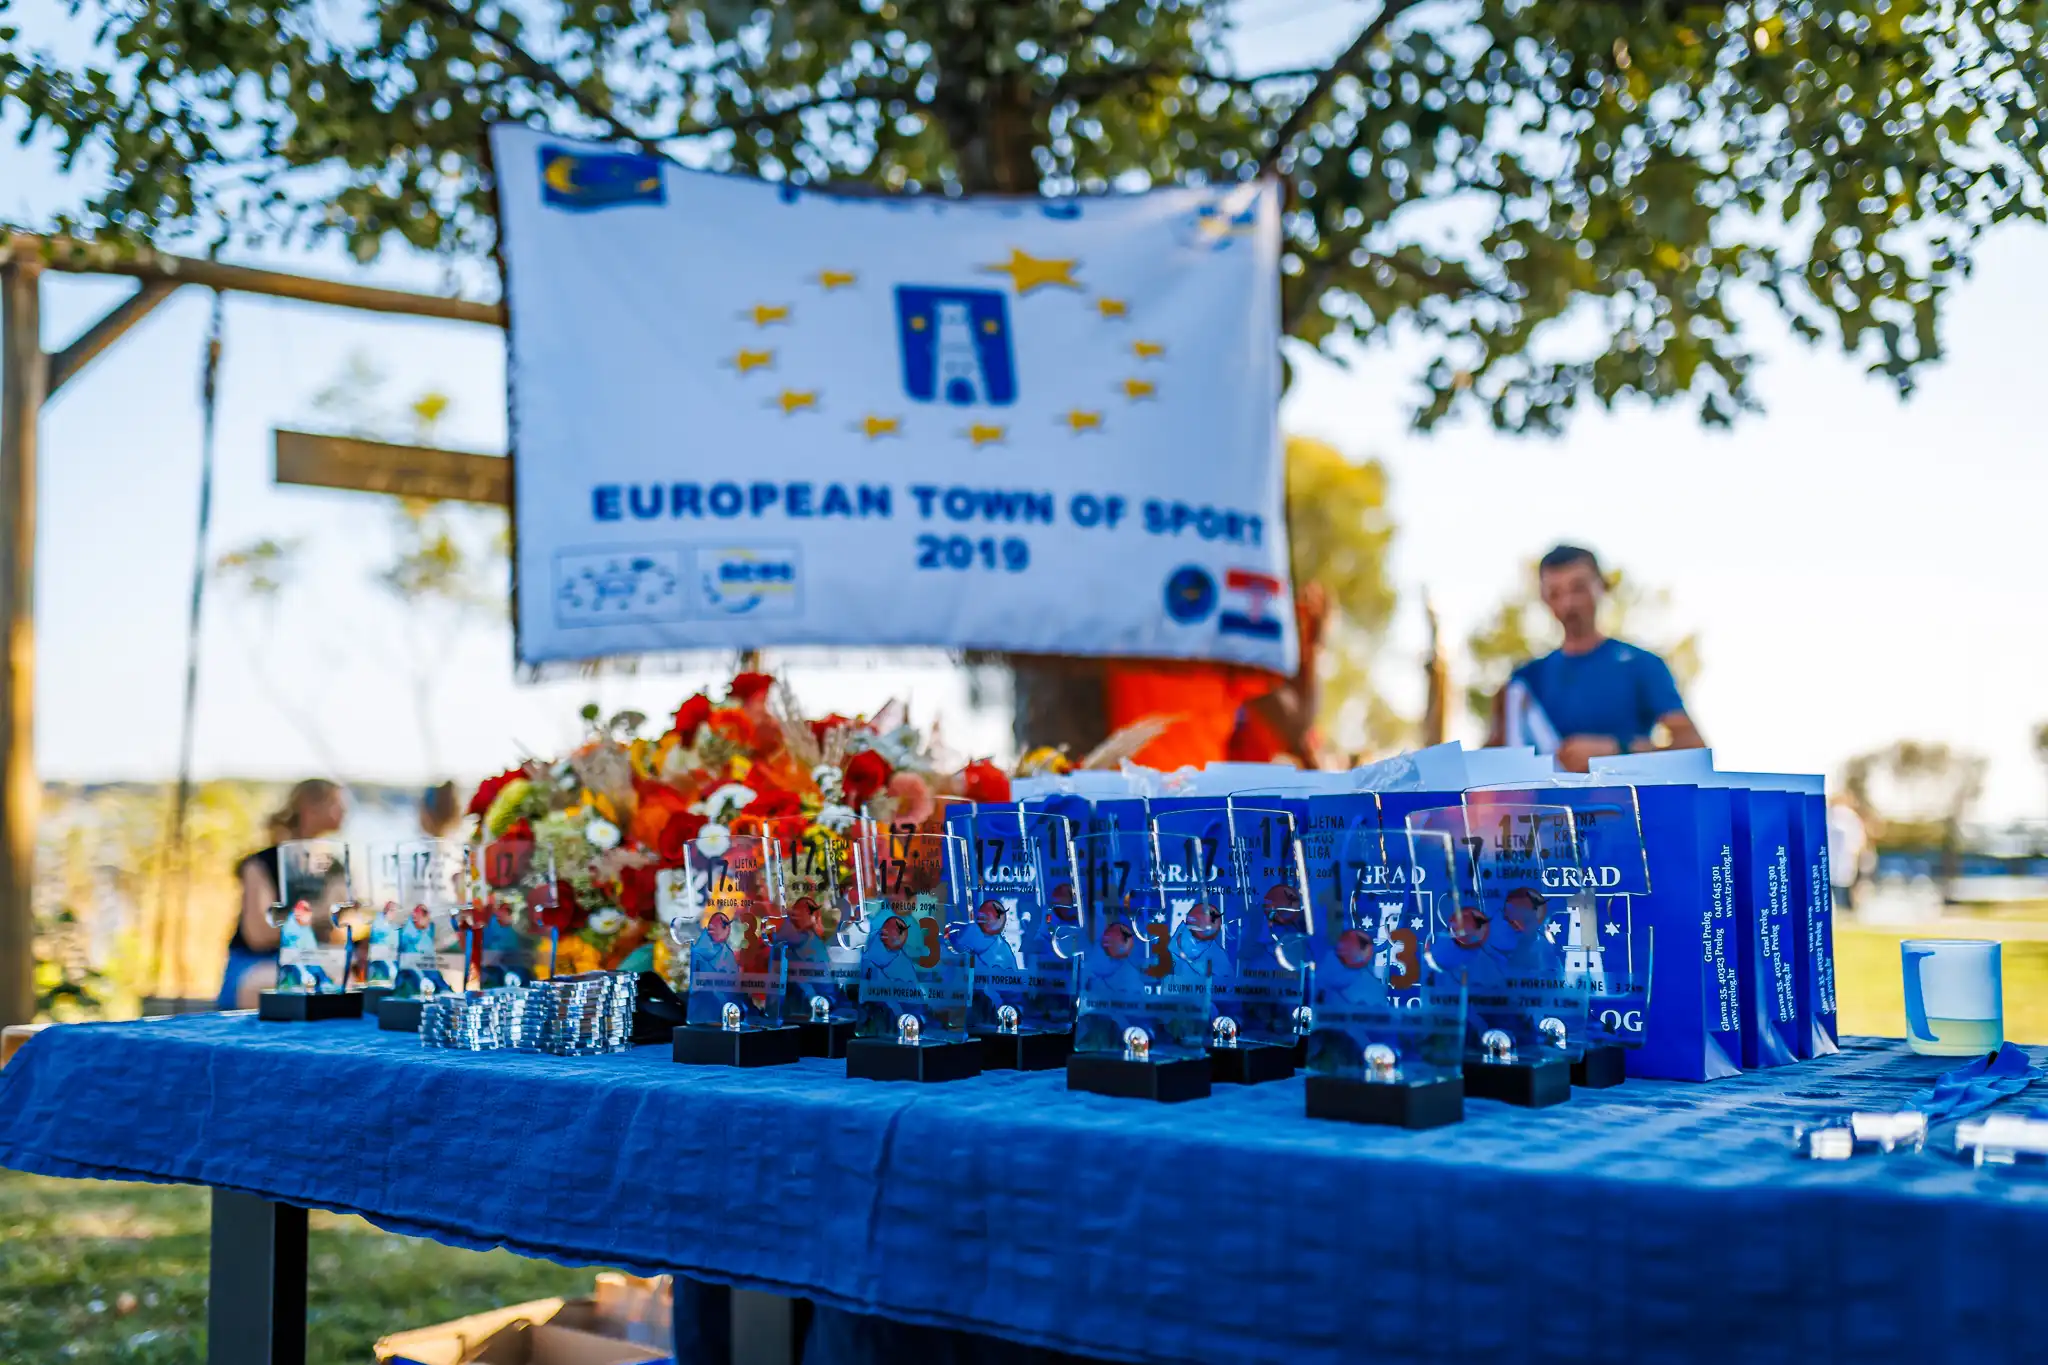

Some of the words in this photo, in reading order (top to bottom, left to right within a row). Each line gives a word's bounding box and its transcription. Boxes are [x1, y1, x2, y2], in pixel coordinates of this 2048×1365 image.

[592, 483, 892, 521] EUROPEAN
[909, 486, 1054, 524] TOWN
[1070, 493, 1123, 528] OF
[1144, 499, 1262, 547] SPORT
[916, 534, 1029, 572] 2019
[1308, 846, 1332, 859] LIGA
[1541, 866, 1621, 888] GRAD
[1712, 866, 1721, 881] 301
[1721, 844, 1733, 918] www.tz-prelog.hr
[1768, 866, 1777, 880] 301
[1712, 883, 1722, 899] 645
[1769, 881, 1778, 897] 645
[893, 901, 918, 910] PRELOG,
[1714, 901, 1723, 918] 040
[1771, 898, 1779, 915] 040
[1702, 911, 1713, 938] Prelog
[1759, 908, 1769, 935] Prelog
[918, 917, 940, 968] 3
[1714, 928, 1725, 955] Prelog
[1761, 936, 1770, 957] Grad
[1770, 924, 1780, 951] Prelog
[1390, 928, 1419, 990] 3
[1703, 941, 1713, 962] Grad
[1773, 952, 1782, 978] 40323
[1717, 957, 1726, 984] 40323
[1727, 968, 1739, 1031] www.prelog.hr
[1778, 993, 1788, 1022] Glavna
[1721, 1001, 1731, 1031] Glavna
